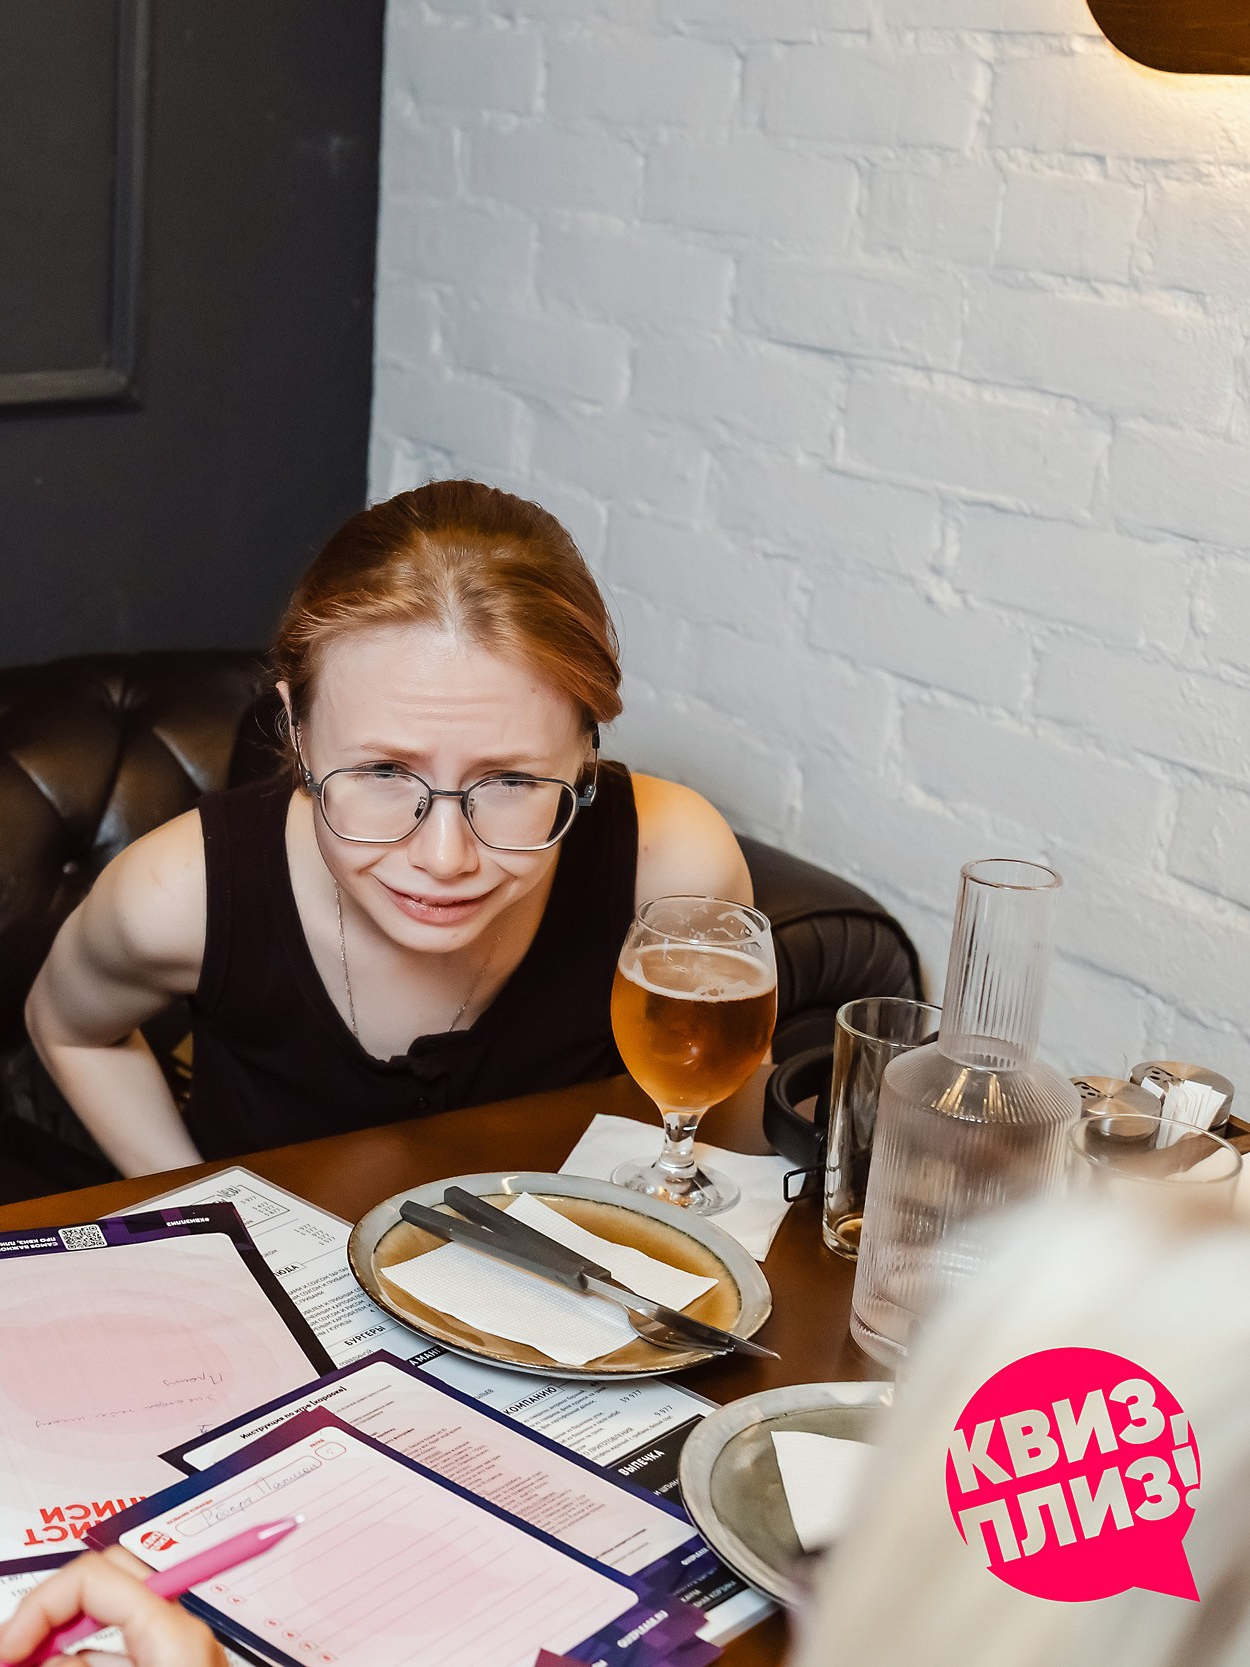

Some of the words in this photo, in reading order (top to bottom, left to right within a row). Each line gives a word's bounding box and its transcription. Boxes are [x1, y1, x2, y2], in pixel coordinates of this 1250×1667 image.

[344, 1325, 386, 1346] БУРГЕРЫ
[503, 1386, 557, 1416] КОМПАНИЮ
[240, 1416, 284, 1439] Инструкция
[618, 1449, 665, 1476] ВЫПЕЧКА
